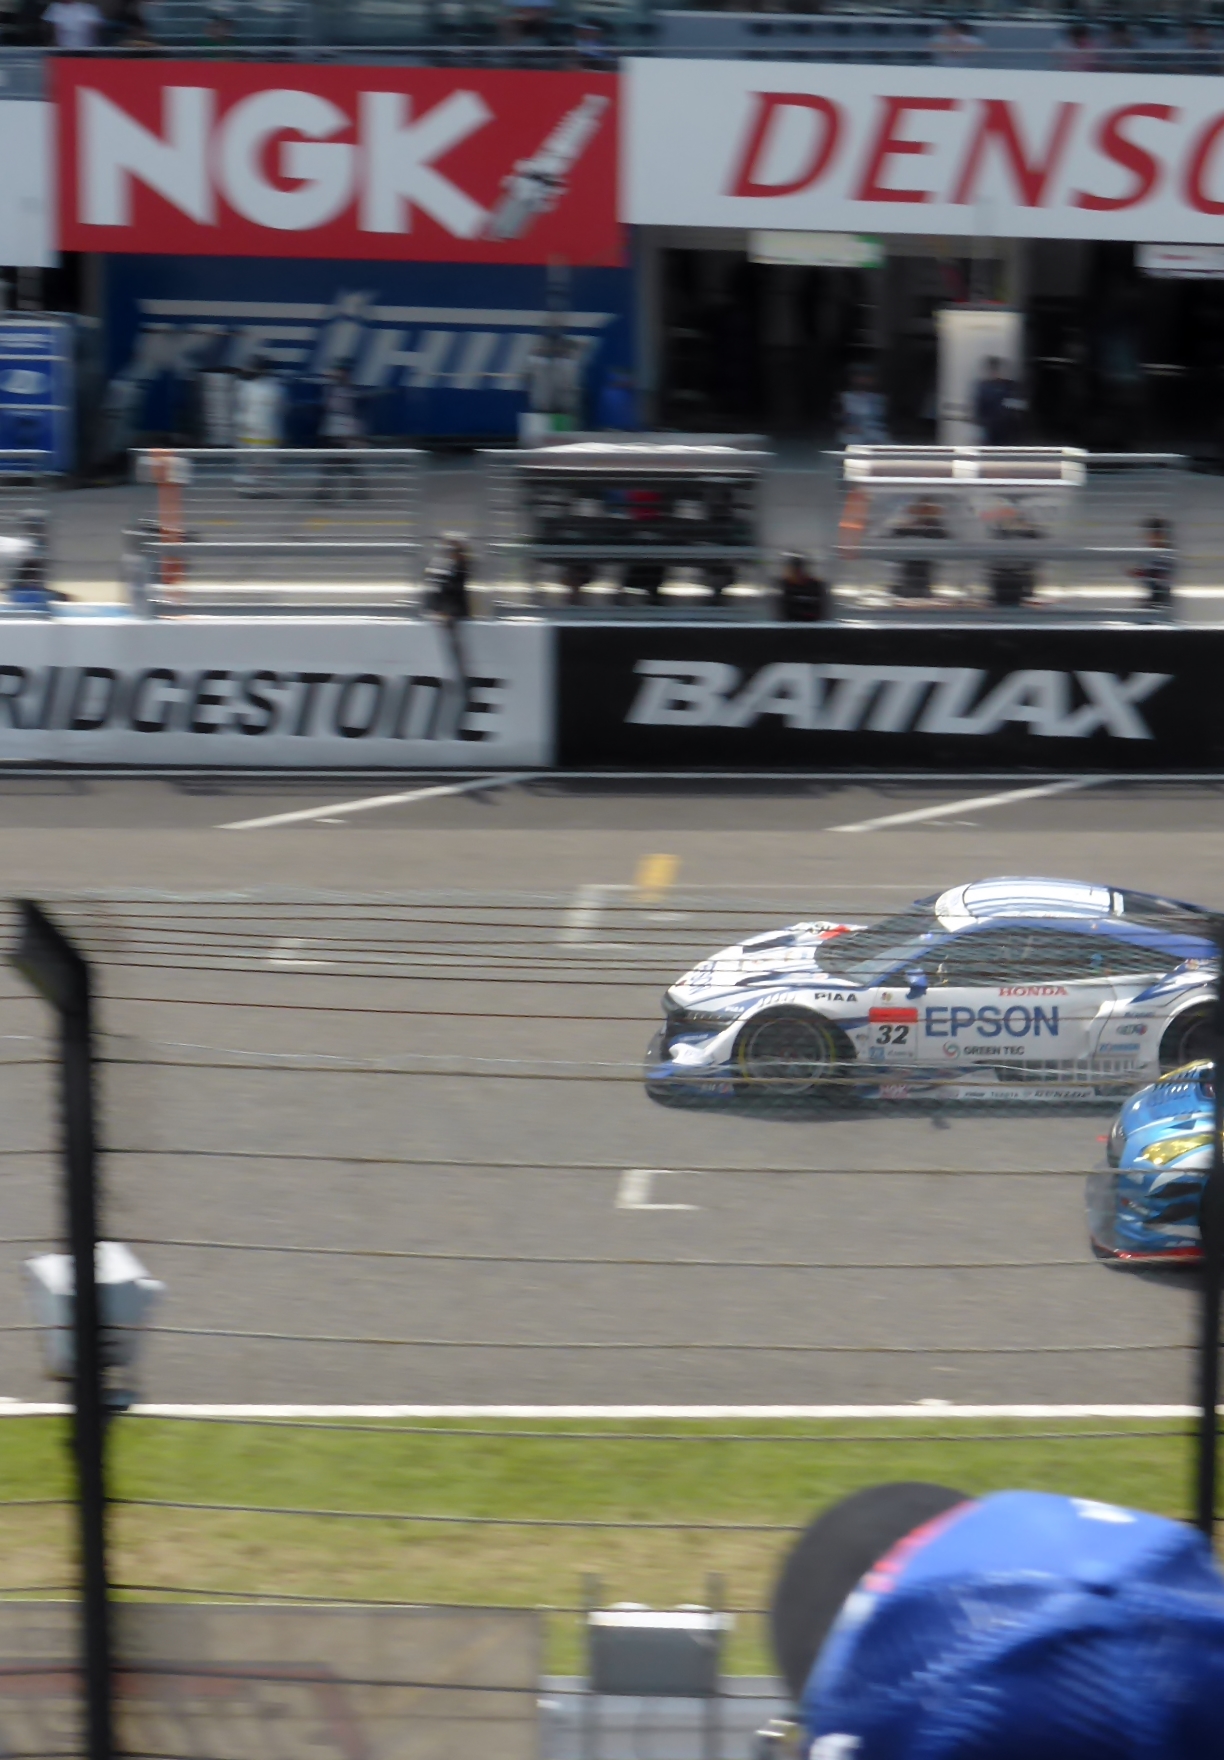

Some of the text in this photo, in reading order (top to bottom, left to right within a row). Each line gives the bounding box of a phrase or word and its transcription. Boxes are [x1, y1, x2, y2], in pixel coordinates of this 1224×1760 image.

[76, 86, 494, 240] NGK
[624, 659, 1173, 740] BATTLAX
[814, 992, 858, 1002] PIAA
[999, 986, 1068, 997] HONDA
[925, 1005, 1059, 1038] EPSON
[876, 1024, 910, 1045] 32
[963, 1046, 1025, 1056] GREEN TEC
